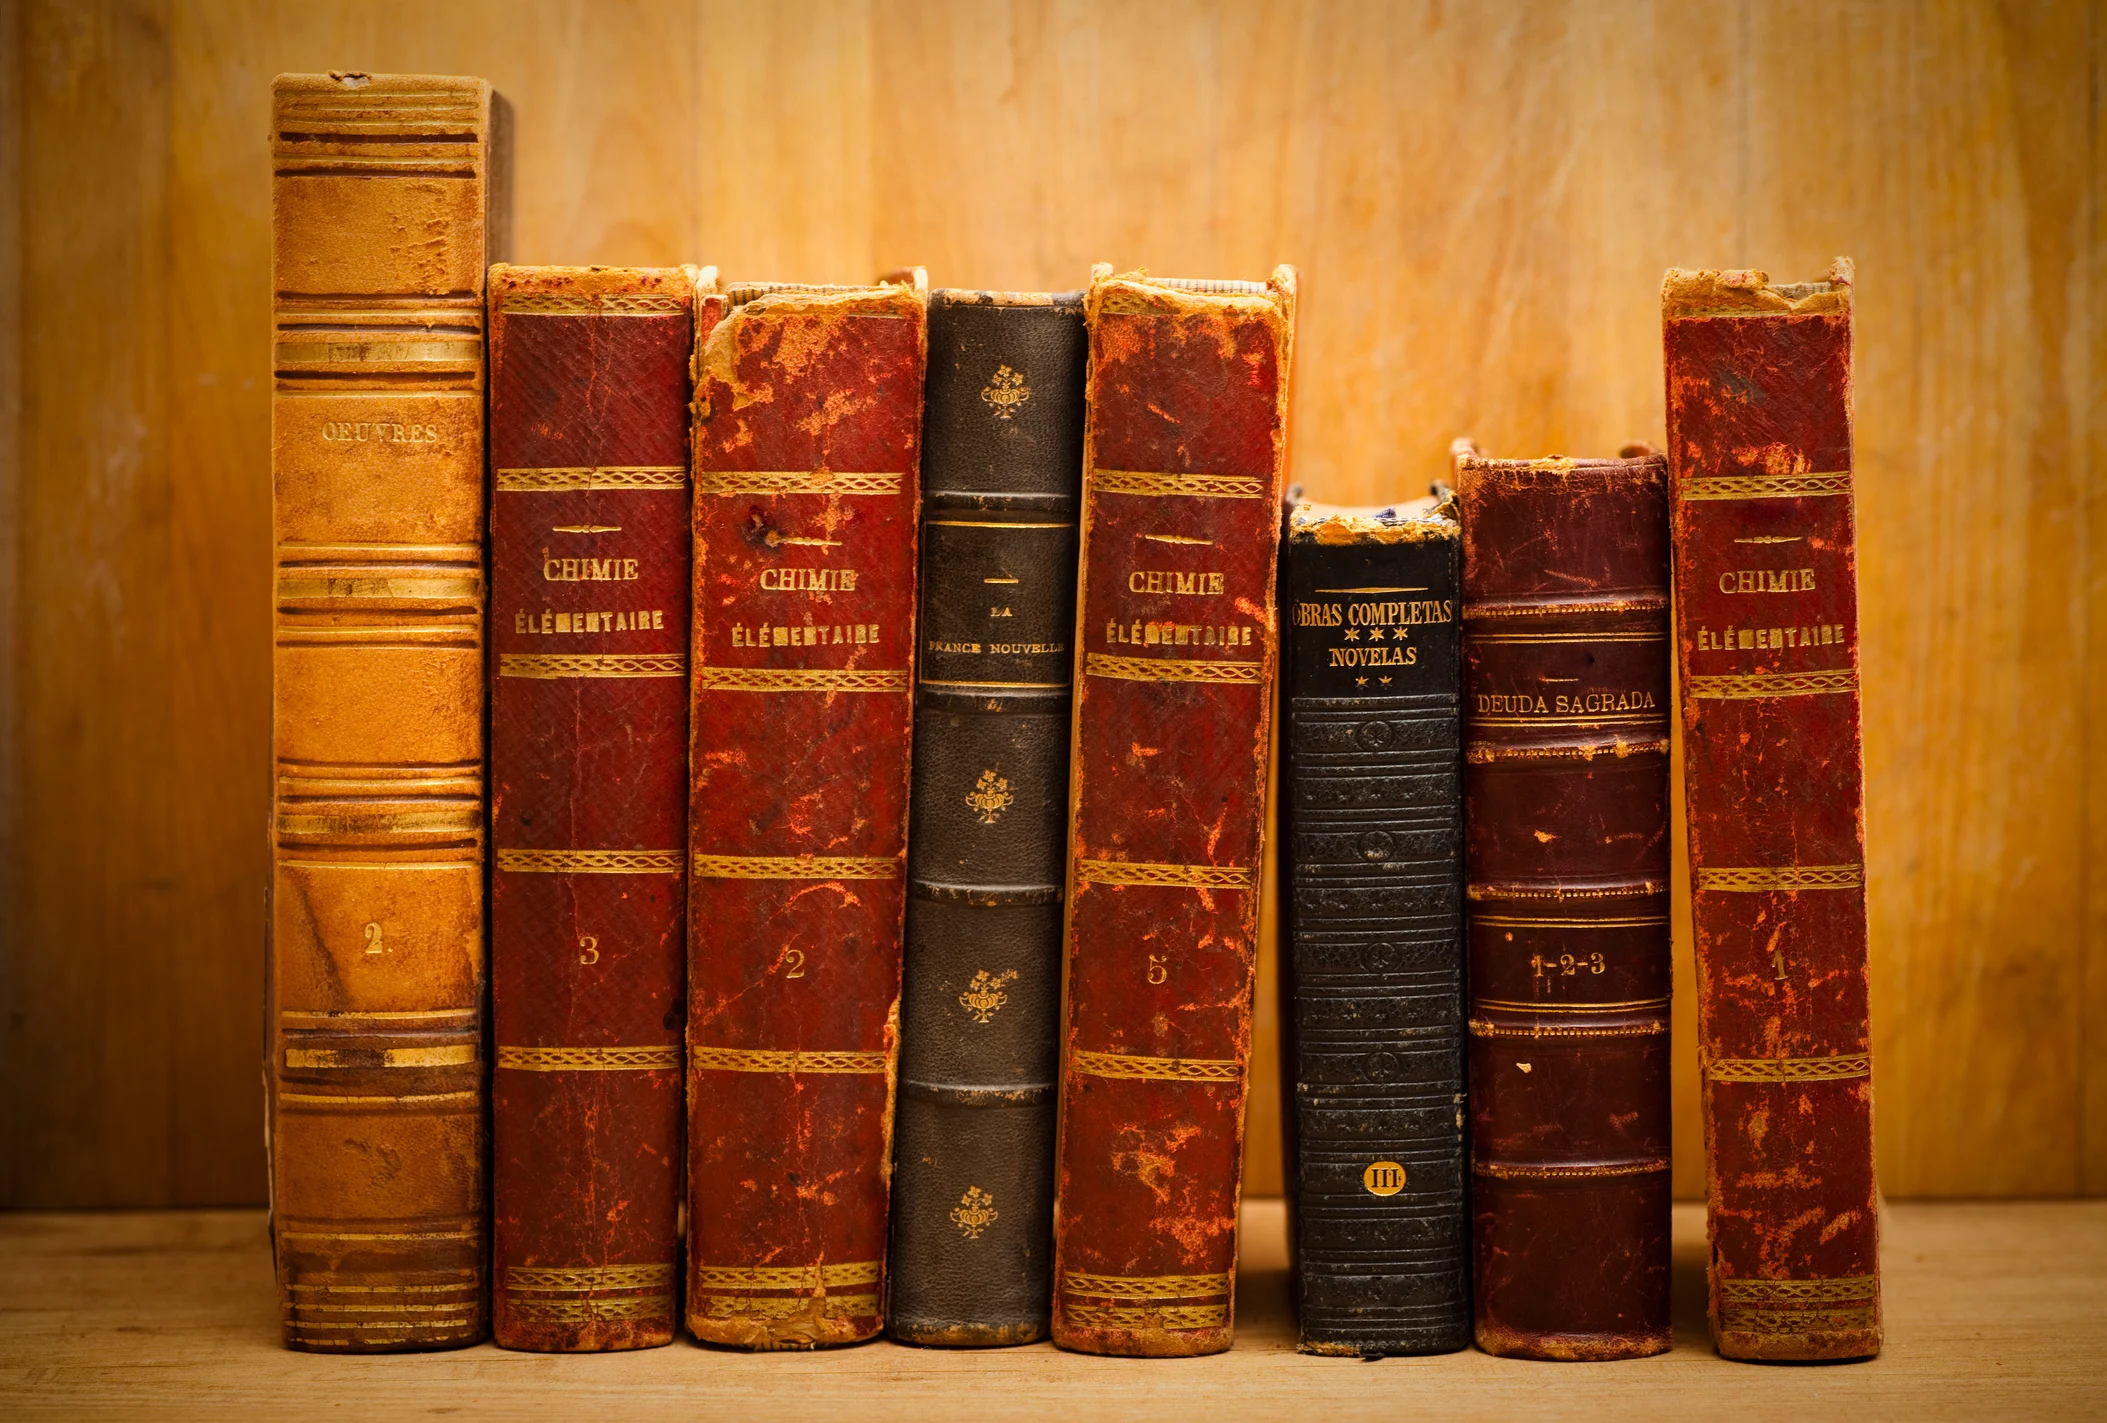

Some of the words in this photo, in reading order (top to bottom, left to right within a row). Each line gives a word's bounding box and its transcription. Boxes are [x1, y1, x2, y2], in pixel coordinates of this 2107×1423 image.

[321, 422, 438, 445] OEUVRES
[543, 558, 639, 582] CHIMIE
[760, 568, 857, 591] CHIMIE
[1719, 569, 1816, 594] CHIMIE
[1129, 571, 1225, 595] CHIMIE
[990, 607, 1013, 618] LA
[1291, 601, 1343, 626] OBRAS
[1348, 600, 1453, 627] COMPLETAS
[929, 641, 981, 654] FRANCE
[990, 642, 1065, 654] NOUVELLE
[1329, 646, 1417, 667] NOVELAS
[1478, 694, 1550, 714] DEUDA
[1556, 691, 1656, 713] SAGRADA
[579, 936, 600, 965] 3
[785, 949, 806, 979] 2
[1147, 955, 1167, 985] 5
[1531, 953, 1606, 977] 1-2-3
[1371, 1168, 1399, 1189] III
